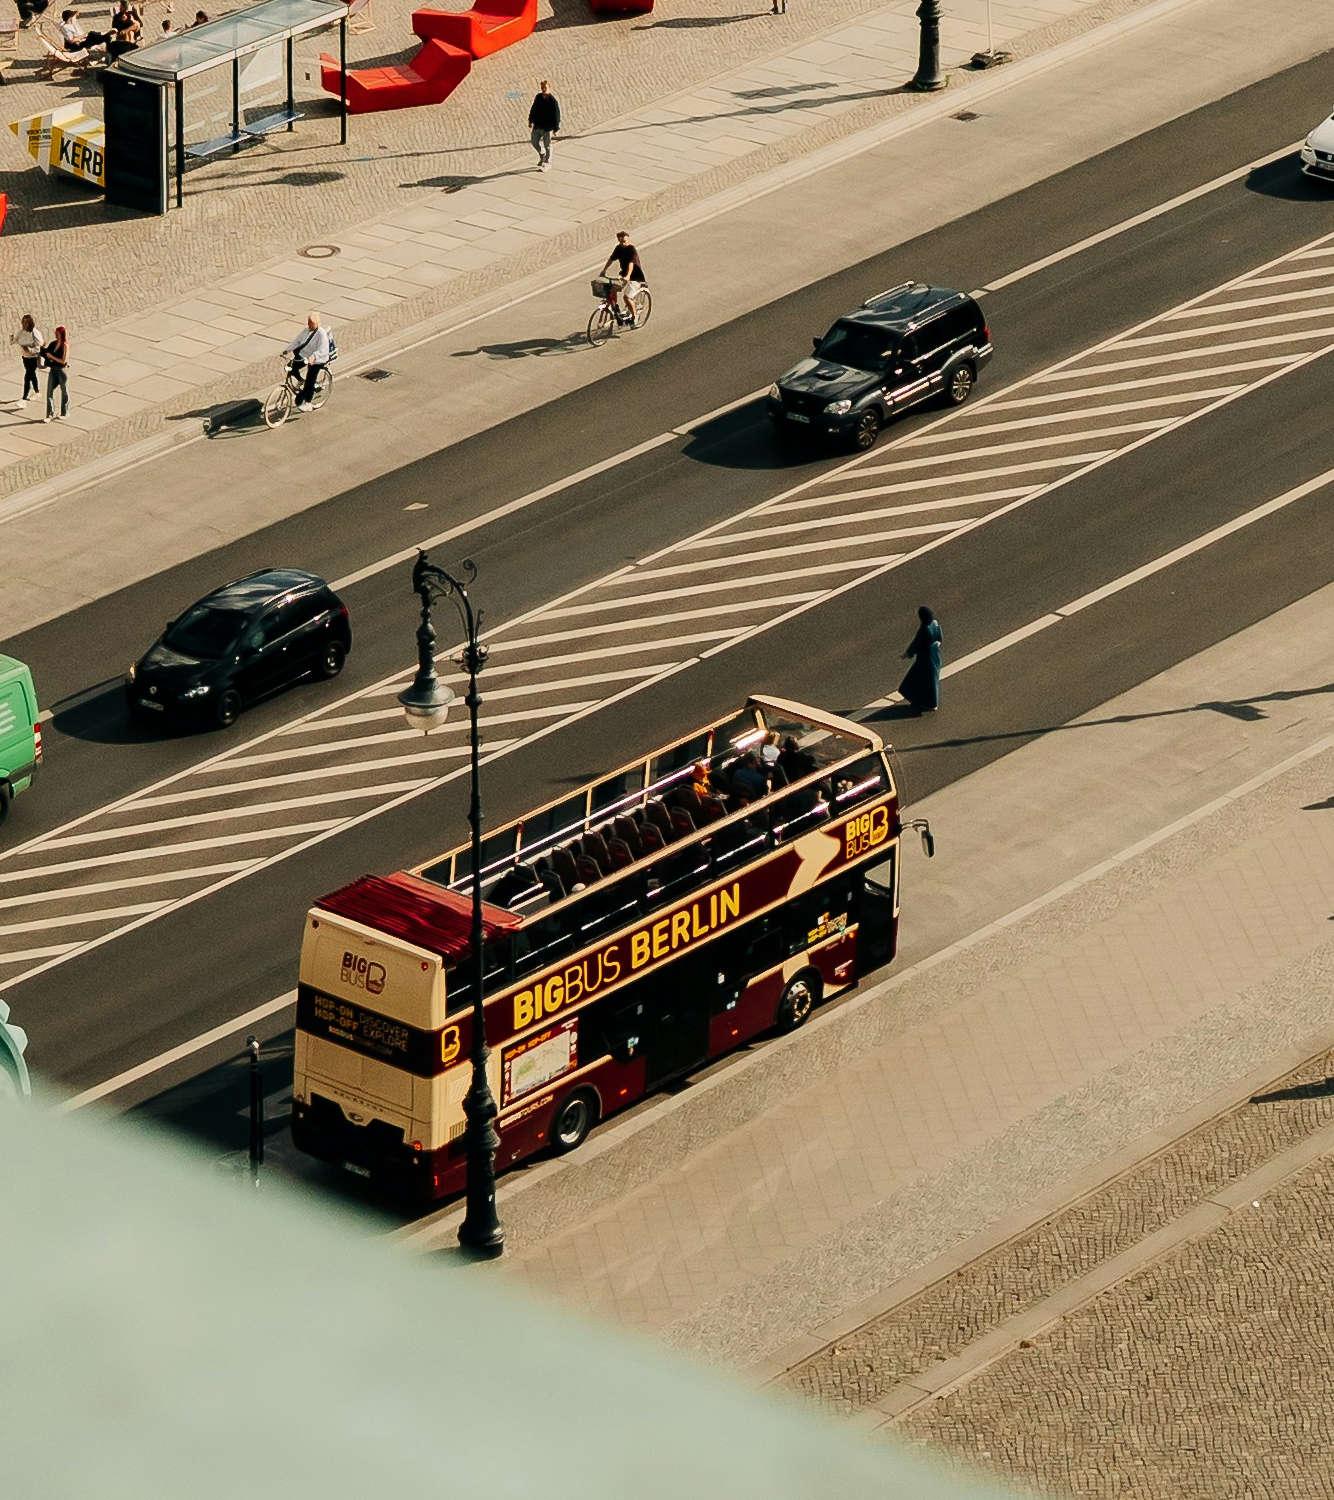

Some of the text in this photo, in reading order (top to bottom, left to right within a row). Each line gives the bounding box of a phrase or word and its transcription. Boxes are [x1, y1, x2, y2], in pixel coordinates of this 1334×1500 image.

[59, 136, 104, 177] KERB
[846, 813, 870, 842] BIG
[846, 833, 871, 860] BUS
[631, 883, 740, 970] BERLIN
[340, 967, 366, 990] BUS
[343, 951, 368, 974] BIG
[315, 995, 409, 1039] HOP-ON DISCOVER
[315, 1007, 409, 1052] HOP-OFF EXPLORE
